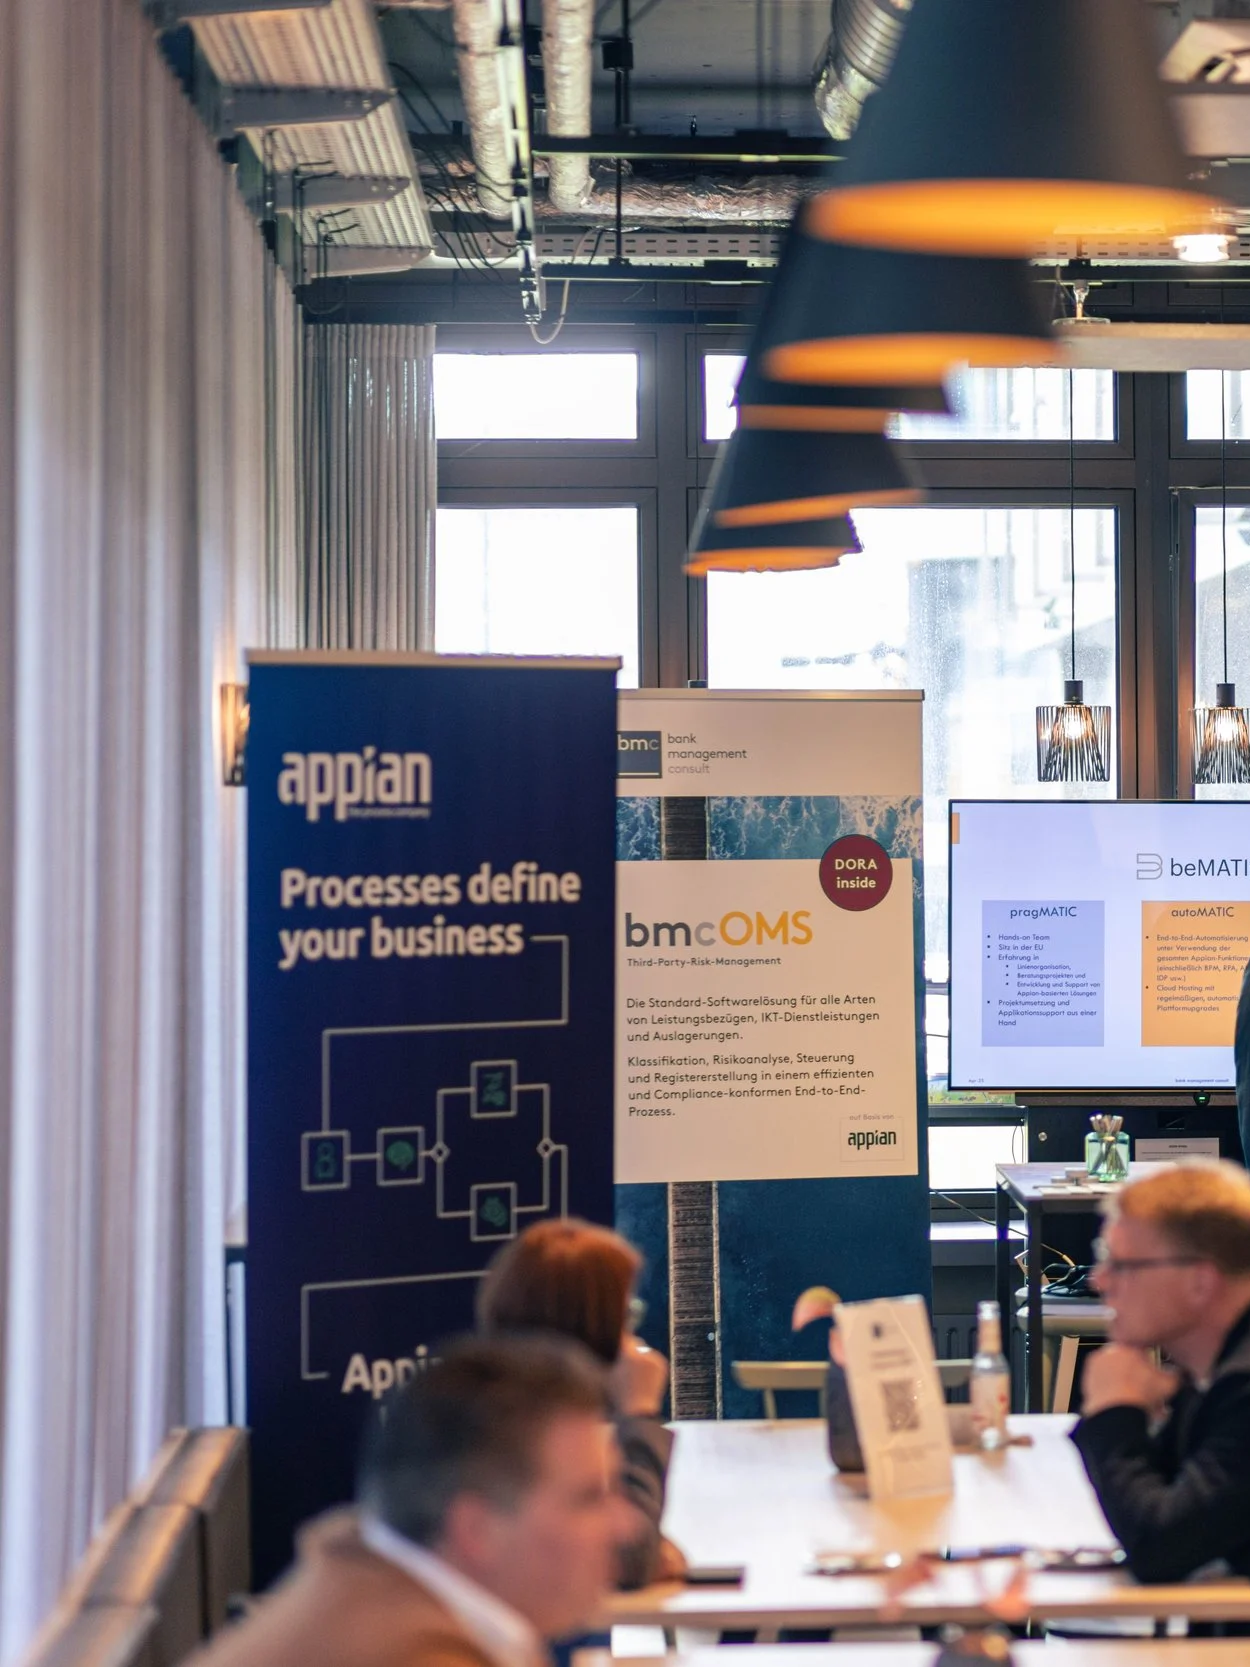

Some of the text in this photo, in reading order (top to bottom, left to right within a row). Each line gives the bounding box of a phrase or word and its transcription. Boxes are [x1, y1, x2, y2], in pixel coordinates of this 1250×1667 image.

[617, 734, 659, 751] bmc
[667, 733, 697, 744] bank
[667, 749, 748, 762] management
[667, 763, 710, 774] consult
[277, 745, 432, 822] appian
[834, 859, 878, 870] DORA
[281, 861, 581, 908] Processes define
[836, 877, 877, 889] inside
[1010, 906, 1077, 919] pragMATIC
[1171, 906, 1235, 918] autoMATIC
[625, 910, 813, 947] bmcOMS
[278, 914, 525, 971] your business
[1175, 944, 1217, 952] Verwendung
[627, 957, 782, 968] Third-Party-Risk-Management
[998, 954, 1031, 962] Erfahrung
[1017, 972, 1074, 980] Beratungsprojekten
[626, 994, 876, 1009] Die Standard-Softwarelösung für alle Arten
[626, 1011, 880, 1027] von Leistungsbezügen, IKT-Dienstleistungen
[627, 1030, 743, 1044] und Auslagerungen.
[627, 1053, 855, 1067] Klassifikation, Risikoanalyse, Steuerung
[628, 1068, 874, 1086] und Registererstellung in einem effizienten
[628, 1084, 866, 1102] und Compliance-konformen End-to-End-
[628, 1106, 676, 1117] Prozess.
[847, 1129, 897, 1150] appian
